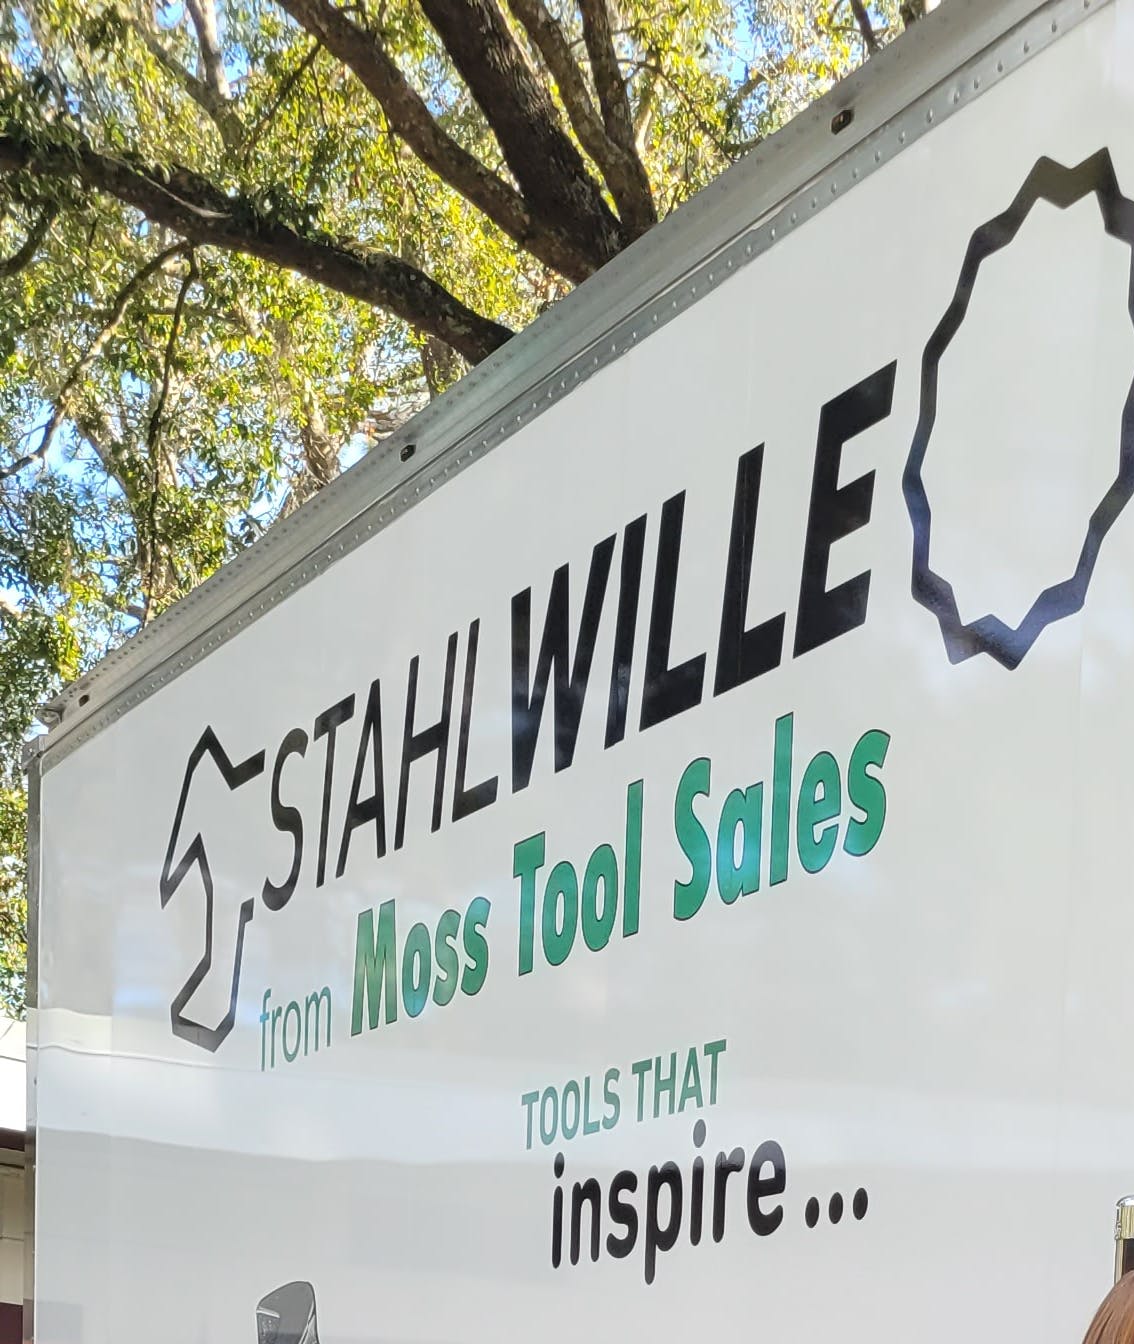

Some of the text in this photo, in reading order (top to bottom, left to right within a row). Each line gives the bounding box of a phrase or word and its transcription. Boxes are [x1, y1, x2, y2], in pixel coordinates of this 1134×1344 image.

[262, 359, 898, 912] STAHLWILLE
[259, 711, 892, 1071] from Moss Tool Sales
[520, 1039, 726, 1150] TOOLS THAT
